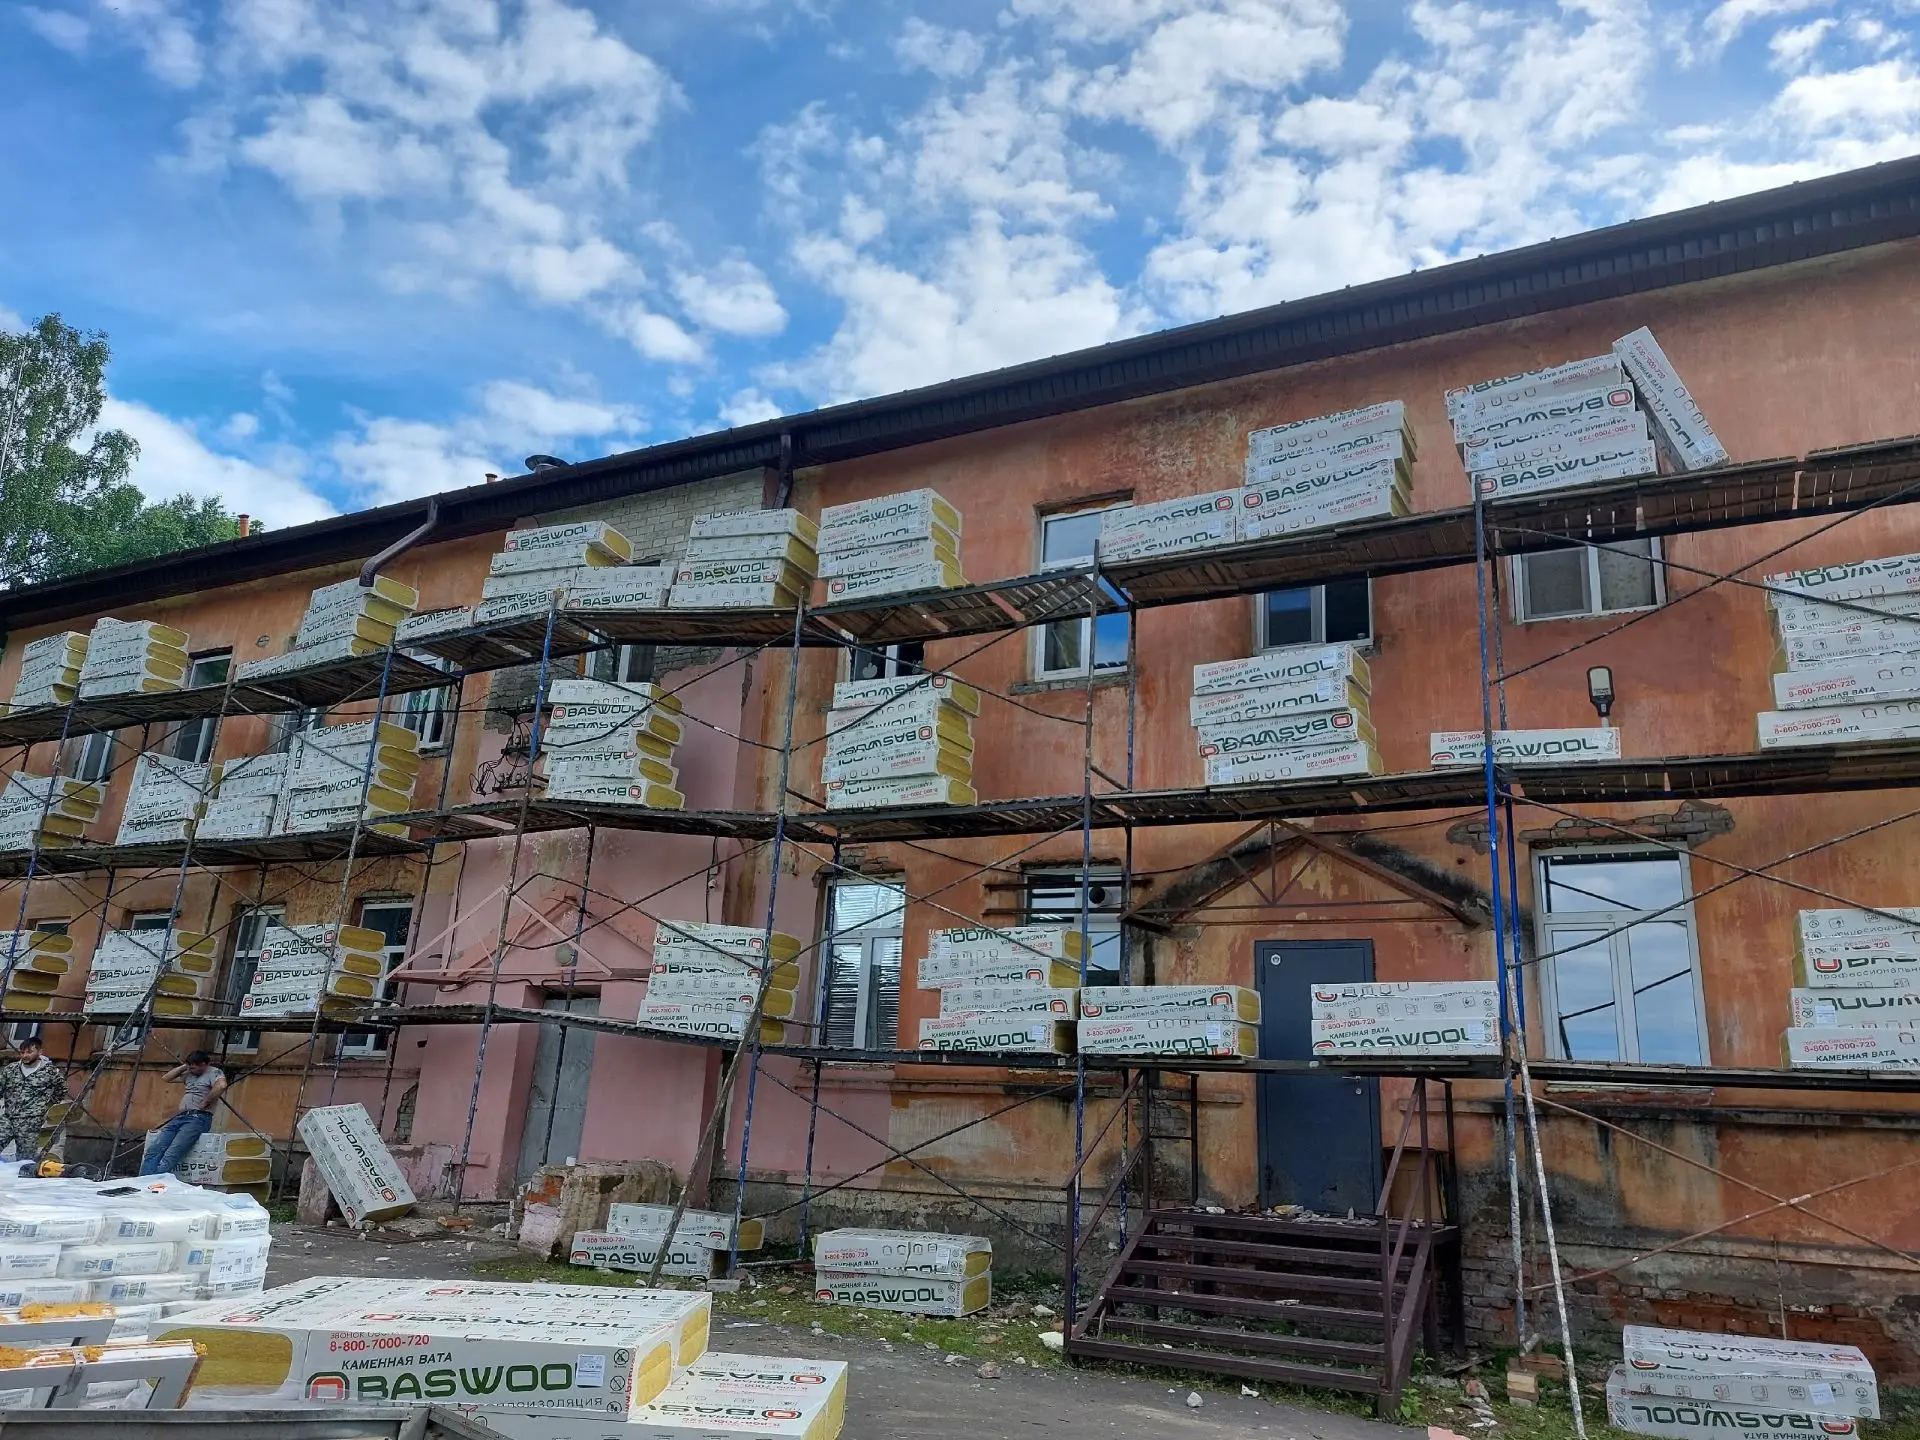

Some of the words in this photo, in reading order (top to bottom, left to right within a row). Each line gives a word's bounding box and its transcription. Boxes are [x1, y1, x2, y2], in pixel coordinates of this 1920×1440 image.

[520, 525, 587, 548] BASWOOL
[693, 562, 770, 580] BASWOOL
[582, 592, 652, 607] BASWOOL
[1788, 680, 1856, 697] 8-800-7000-720
[1851, 686, 1876, 695] ВАТА
[1774, 717, 1841, 734] 8-800-7000-720
[253, 992, 311, 1007] BASWOOL
[1329, 1030, 1368, 1040] КАМЕННАЯ
[1804, 1041, 1876, 1052] 8-800-7000-720
[1816, 1053, 1868, 1062] КАМЕННАЯ
[1871, 1050, 1896, 1058] ВАТА
[336, 1116, 386, 1187] BASWOOL
[838, 1289, 944, 1302] BASWOOL
[330, 1335, 430, 1352] 8-800-7000-720
[342, 1355, 413, 1370] КАМЕННАЯ
[418, 1352, 452, 1364] ВАТА
[358, 1363, 578, 1400] BASWOO
[1631, 1406, 1814, 1429] BASWOOL
